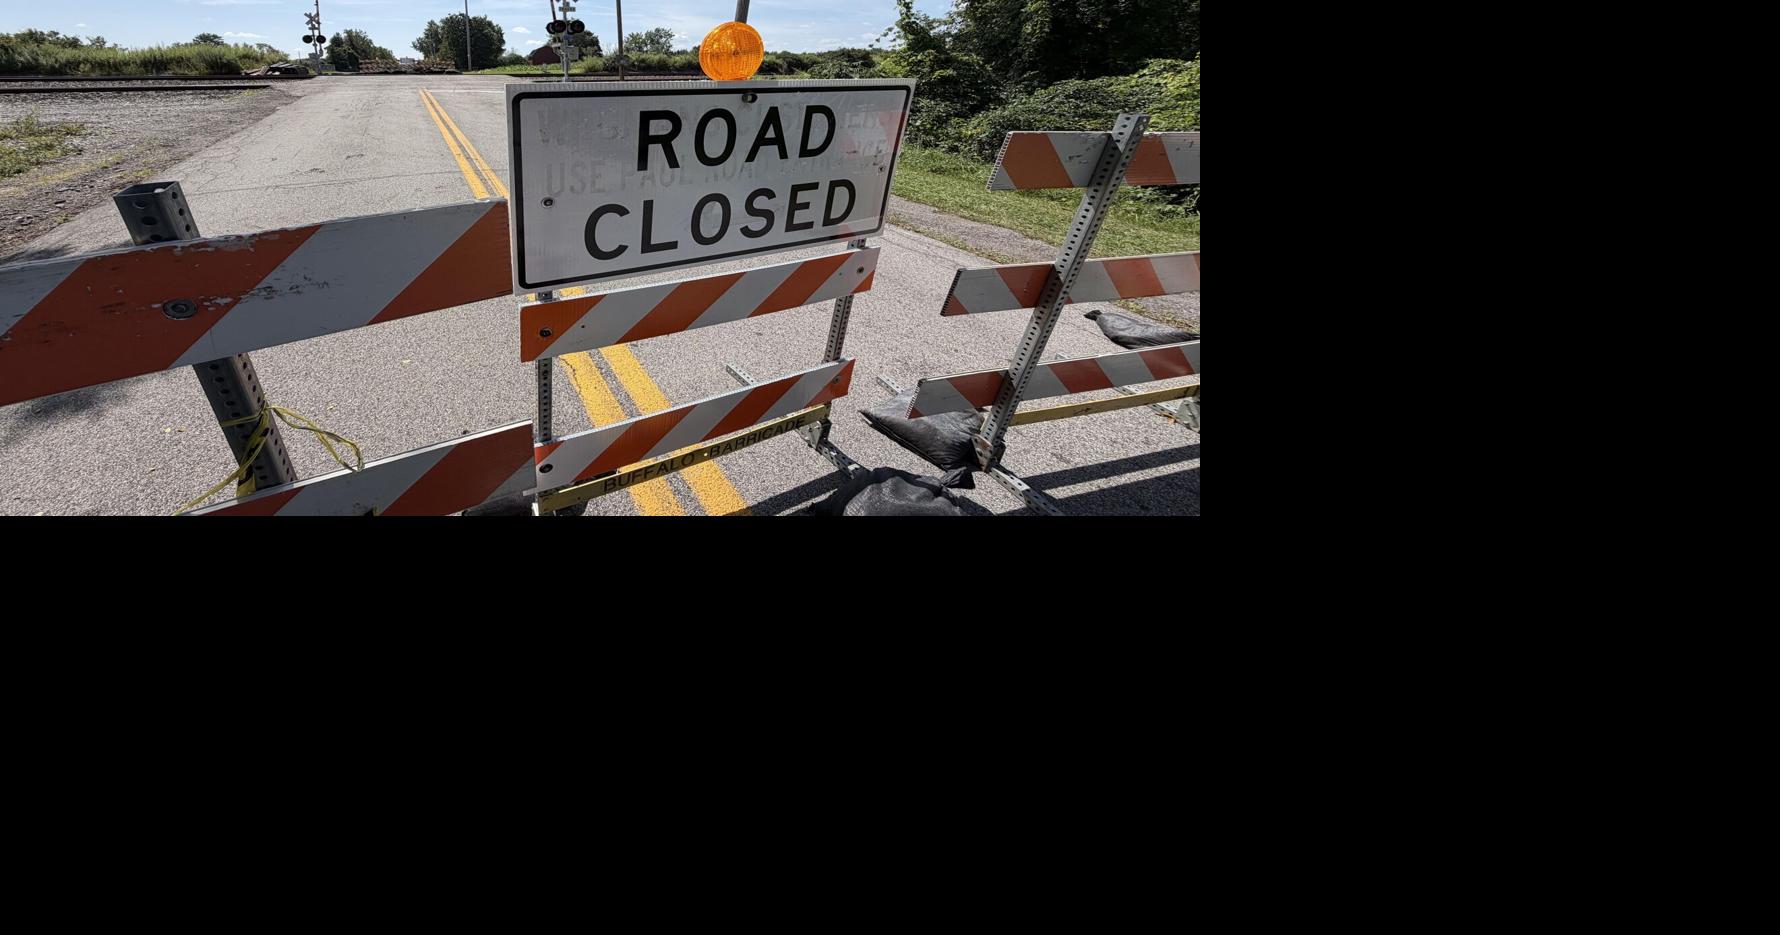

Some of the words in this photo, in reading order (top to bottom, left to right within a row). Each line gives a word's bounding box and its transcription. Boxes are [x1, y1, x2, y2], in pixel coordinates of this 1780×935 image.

[636, 104, 837, 172] ROAD
[546, 160, 607, 199] USE
[584, 179, 857, 261] CLOSED
[602, 453, 695, 493] BUFFALO
[708, 416, 807, 458] BARRICADE
